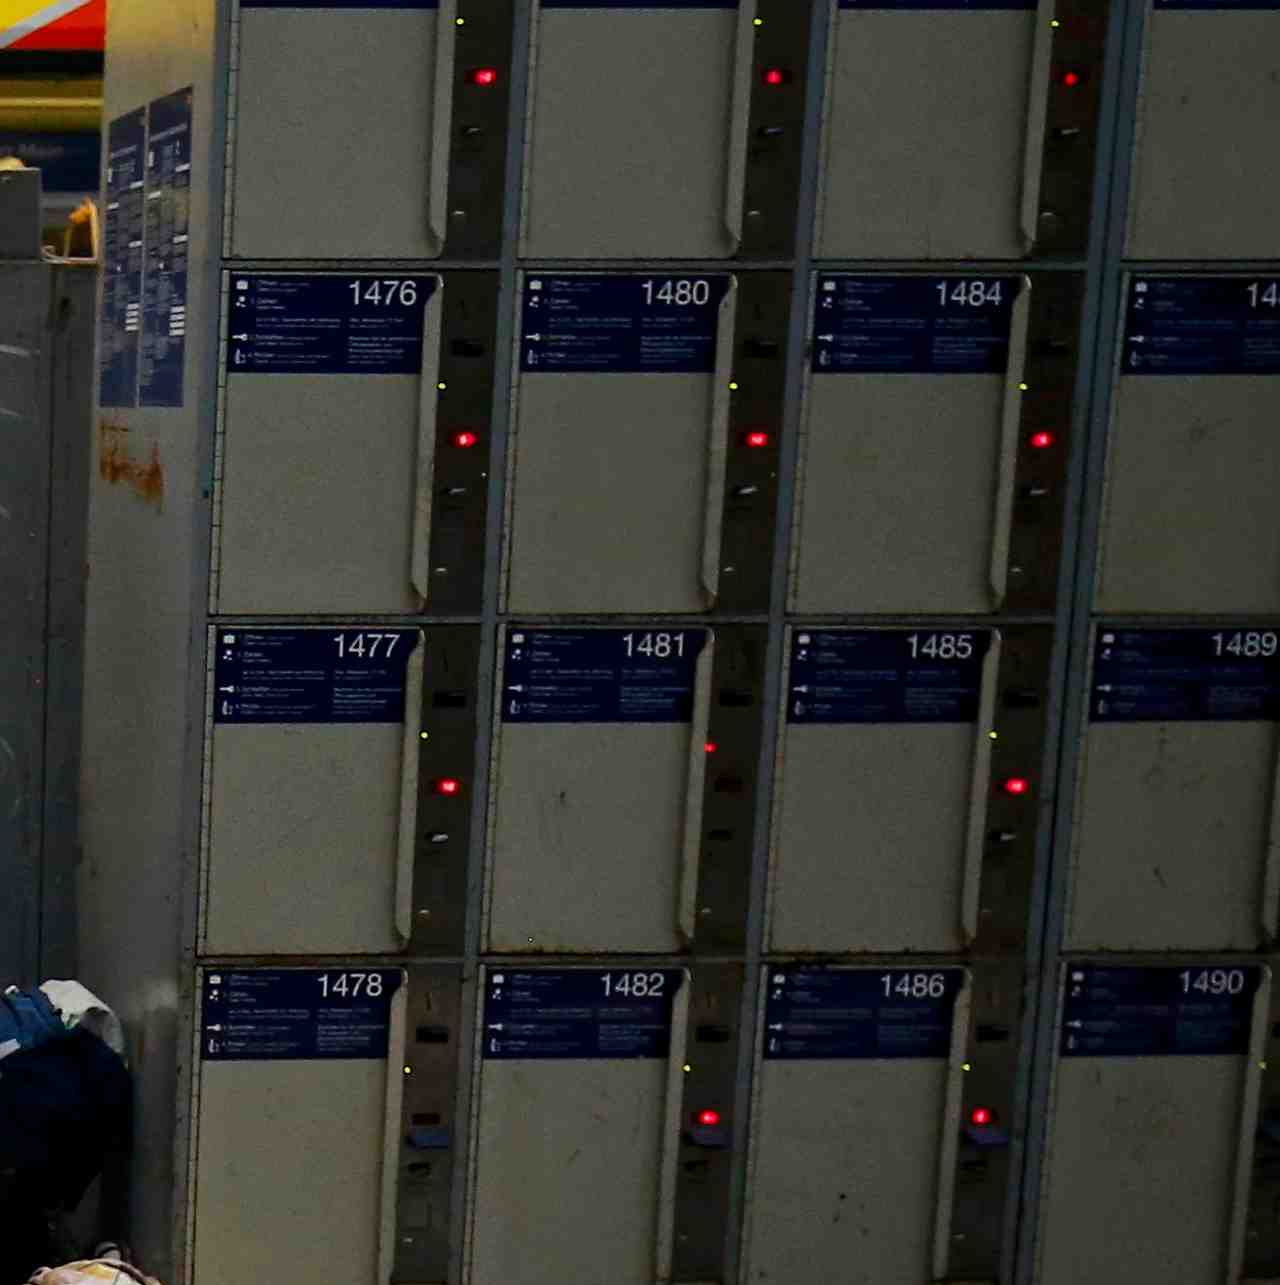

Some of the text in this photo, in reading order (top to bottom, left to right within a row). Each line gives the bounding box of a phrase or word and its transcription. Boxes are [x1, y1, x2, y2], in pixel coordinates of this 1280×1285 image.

[348, 280, 417, 306] 1476
[641, 280, 710, 306] 1480
[935, 281, 1002, 307] 1484
[1246, 282, 1280, 308] 14
[332, 633, 400, 659] 1477
[622, 633, 685, 658] 1481
[907, 633, 973, 659] 1485
[1211, 632, 1278, 657] 1489
[317, 973, 383, 998] 1478
[600, 972, 665, 997] 1482
[880, 973, 945, 998] 1486
[1180, 970, 1245, 995] 1490
